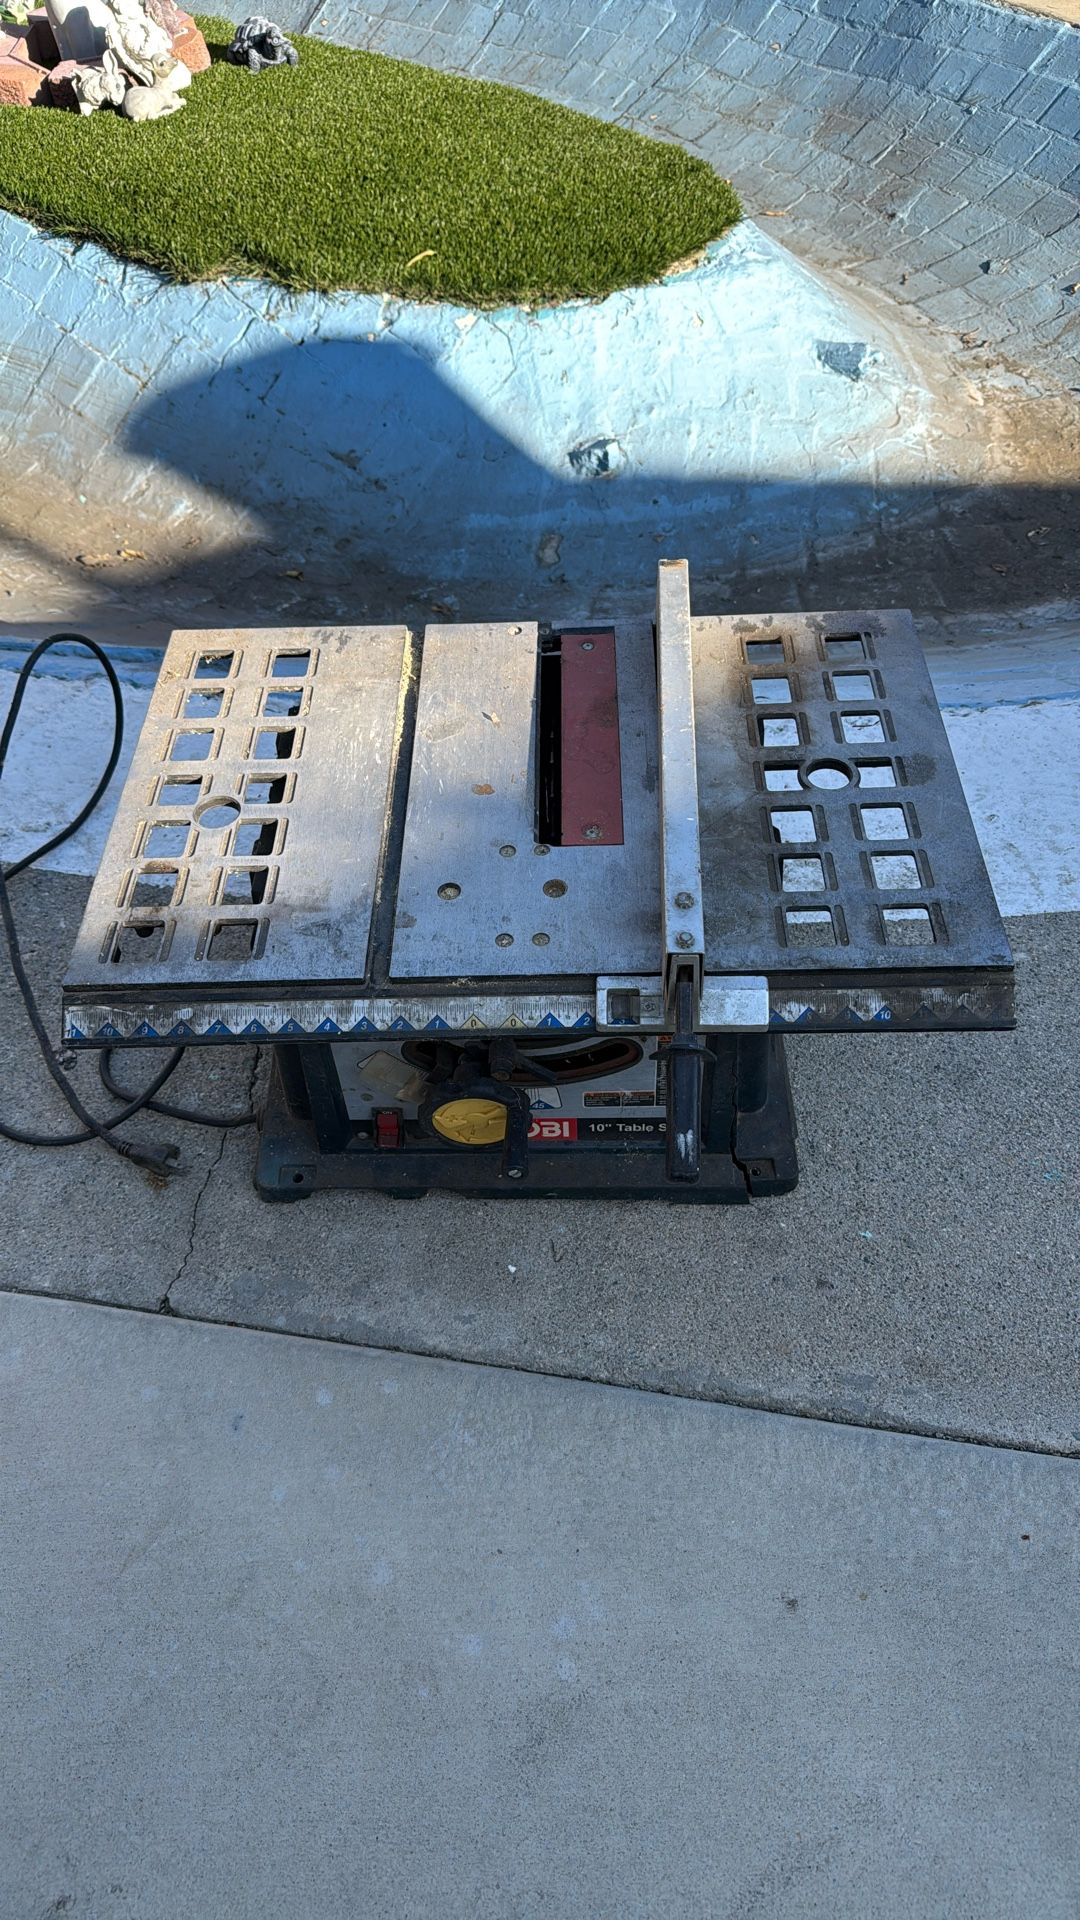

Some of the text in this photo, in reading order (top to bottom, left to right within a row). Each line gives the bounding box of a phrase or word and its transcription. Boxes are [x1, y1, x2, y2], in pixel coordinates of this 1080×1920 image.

[141, 1026, 148, 1035] 9
[177, 1025, 184, 1034] 8
[214, 1025, 221, 1033] 7
[250, 1024, 257, 1032] 6
[287, 1023, 294, 1031] 5
[324, 1022, 330, 1031] 4
[361, 1021, 367, 1030] 3
[397, 1020, 404, 1029] 2
[434, 1020, 439, 1029] 1
[470, 1019, 477, 1027] 0
[510, 1018, 516, 1027] 0
[546, 1018, 552, 1026] 1
[583, 1017, 591, 1026] 2
[880, 1010, 892, 1020] 10
[528, 1121, 570, 1138] OBI
[589, 1123, 612, 1132] 10"
[616, 1123, 654, 1132] Table
